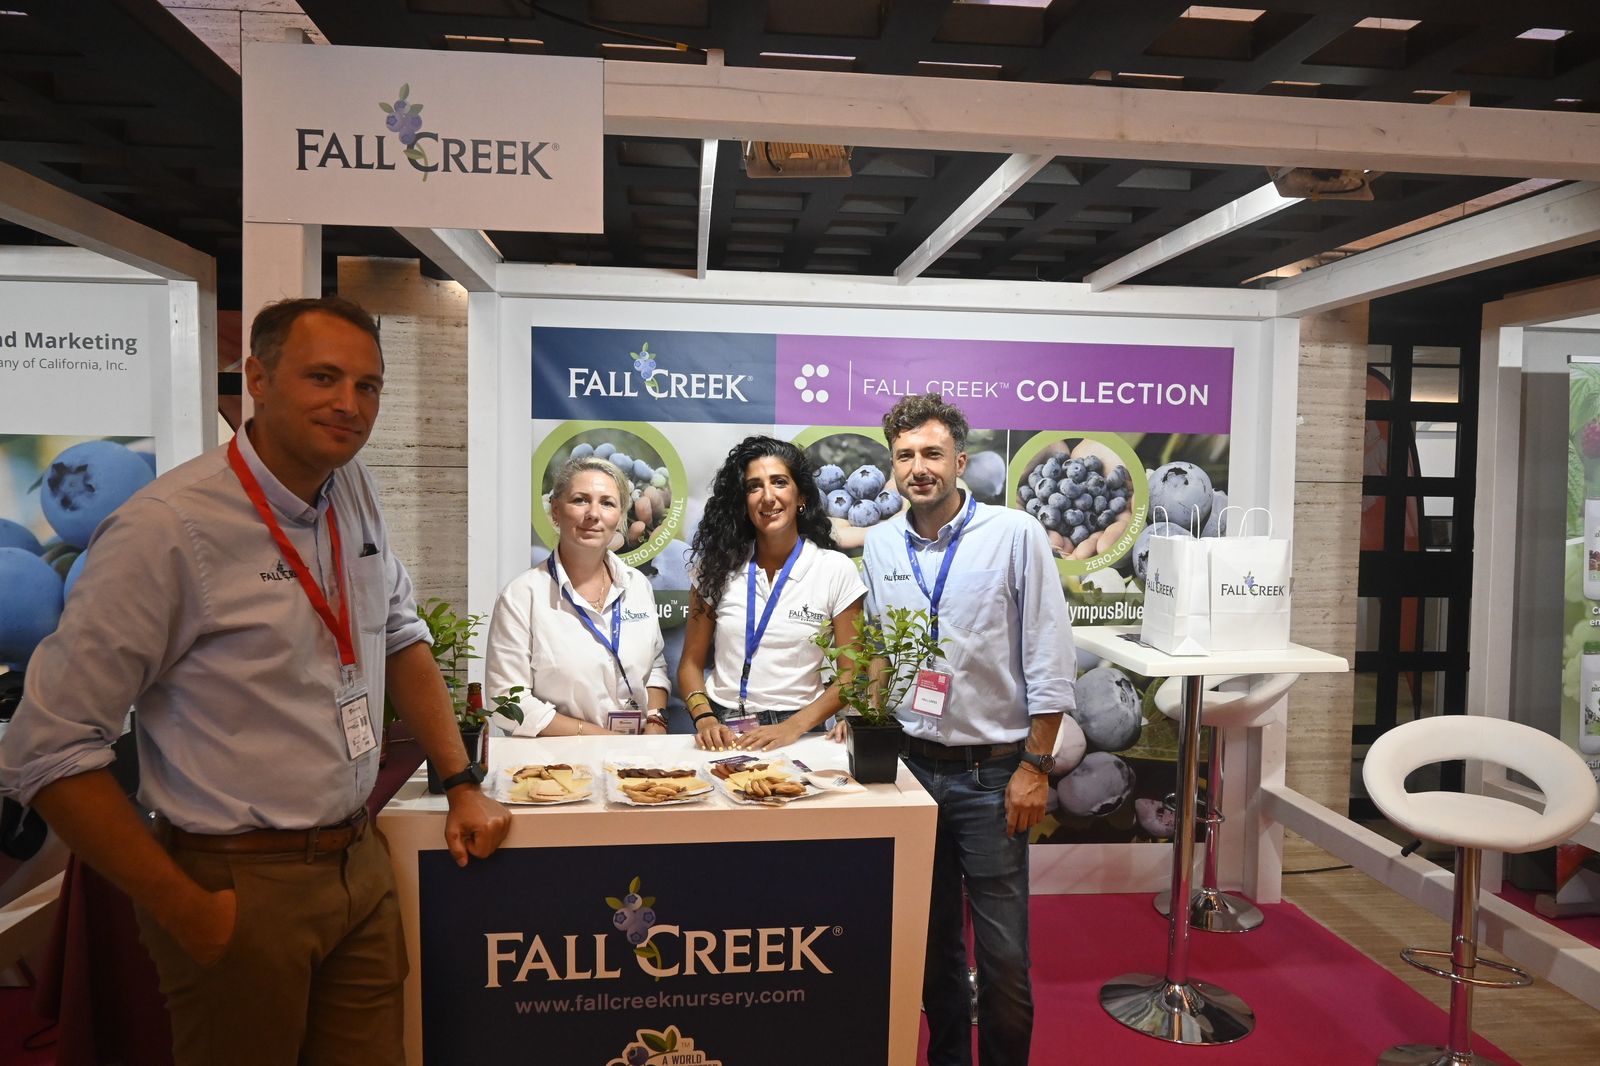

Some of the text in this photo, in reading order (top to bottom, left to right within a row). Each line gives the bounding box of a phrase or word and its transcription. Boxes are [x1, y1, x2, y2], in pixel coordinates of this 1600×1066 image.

[295, 128, 396, 170] FALL
[0, 330, 138, 355] d Marketing
[22, 357, 36, 369] of
[38, 358, 102, 371] California,
[106, 360, 128, 371] Inc.
[568, 367, 639, 398] FALL
[863, 378, 918, 396] FALL
[1016, 379, 1209, 406] COLLECTION
[667, 497, 684, 530] CHILL
[1085, 504, 1146, 572] ZERO-LOW CHILL
[259, 572, 283, 582] FALL
[1221, 583, 1247, 596] FALL
[484, 932, 622, 988] FALL
[515, 987, 806, 1015] www.fallcreeknursery.com
[662, 1054, 702, 1066] A WORLD
